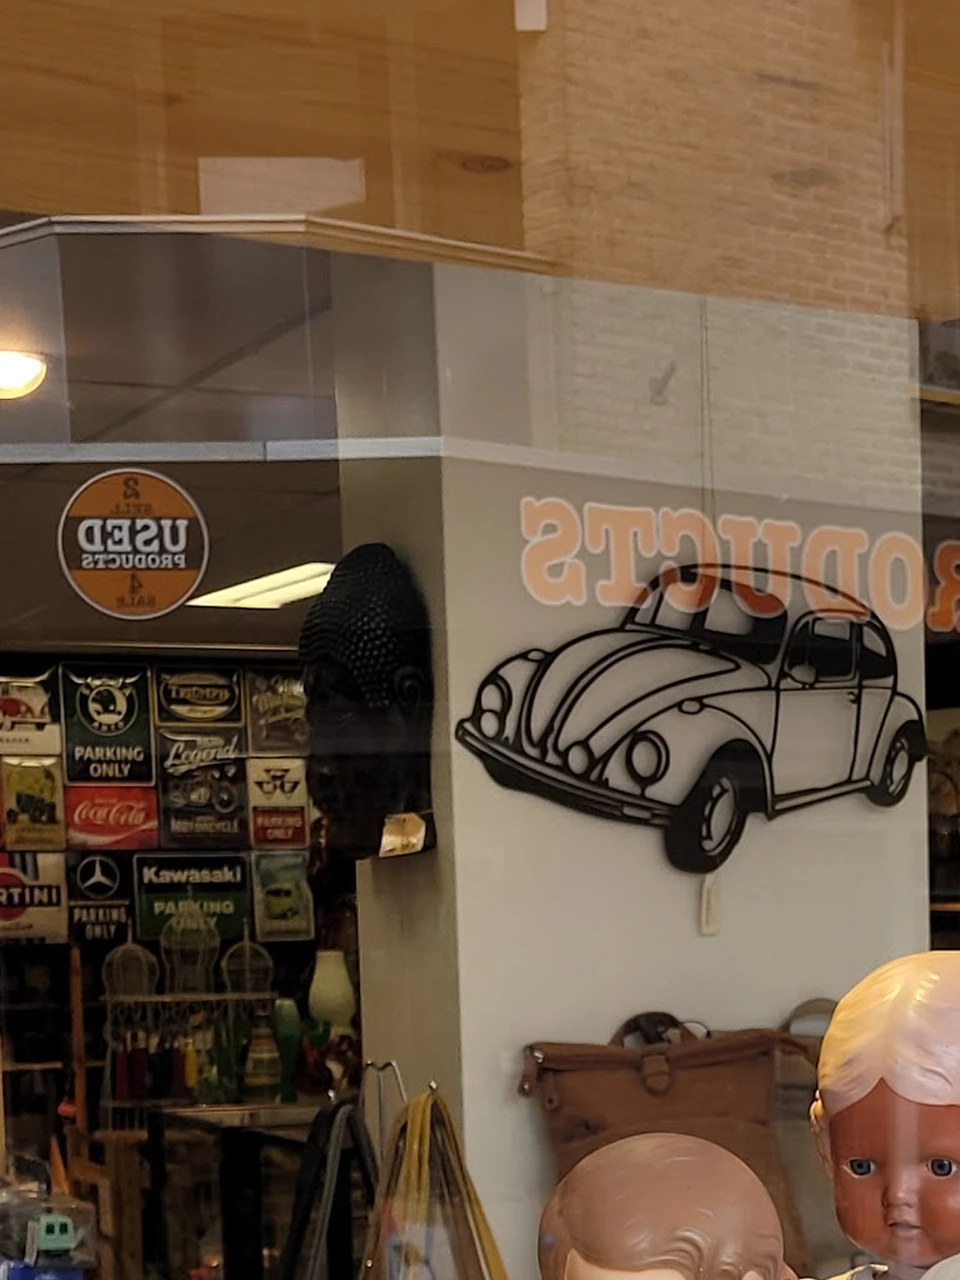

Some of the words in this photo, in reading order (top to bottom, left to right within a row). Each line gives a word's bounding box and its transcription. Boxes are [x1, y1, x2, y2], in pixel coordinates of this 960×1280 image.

[74, 745, 145, 763] PARKING
[89, 763, 132, 779] ONLY
[142, 866, 242, 884] Kawasaki
[153, 900, 235, 916] PARKING
